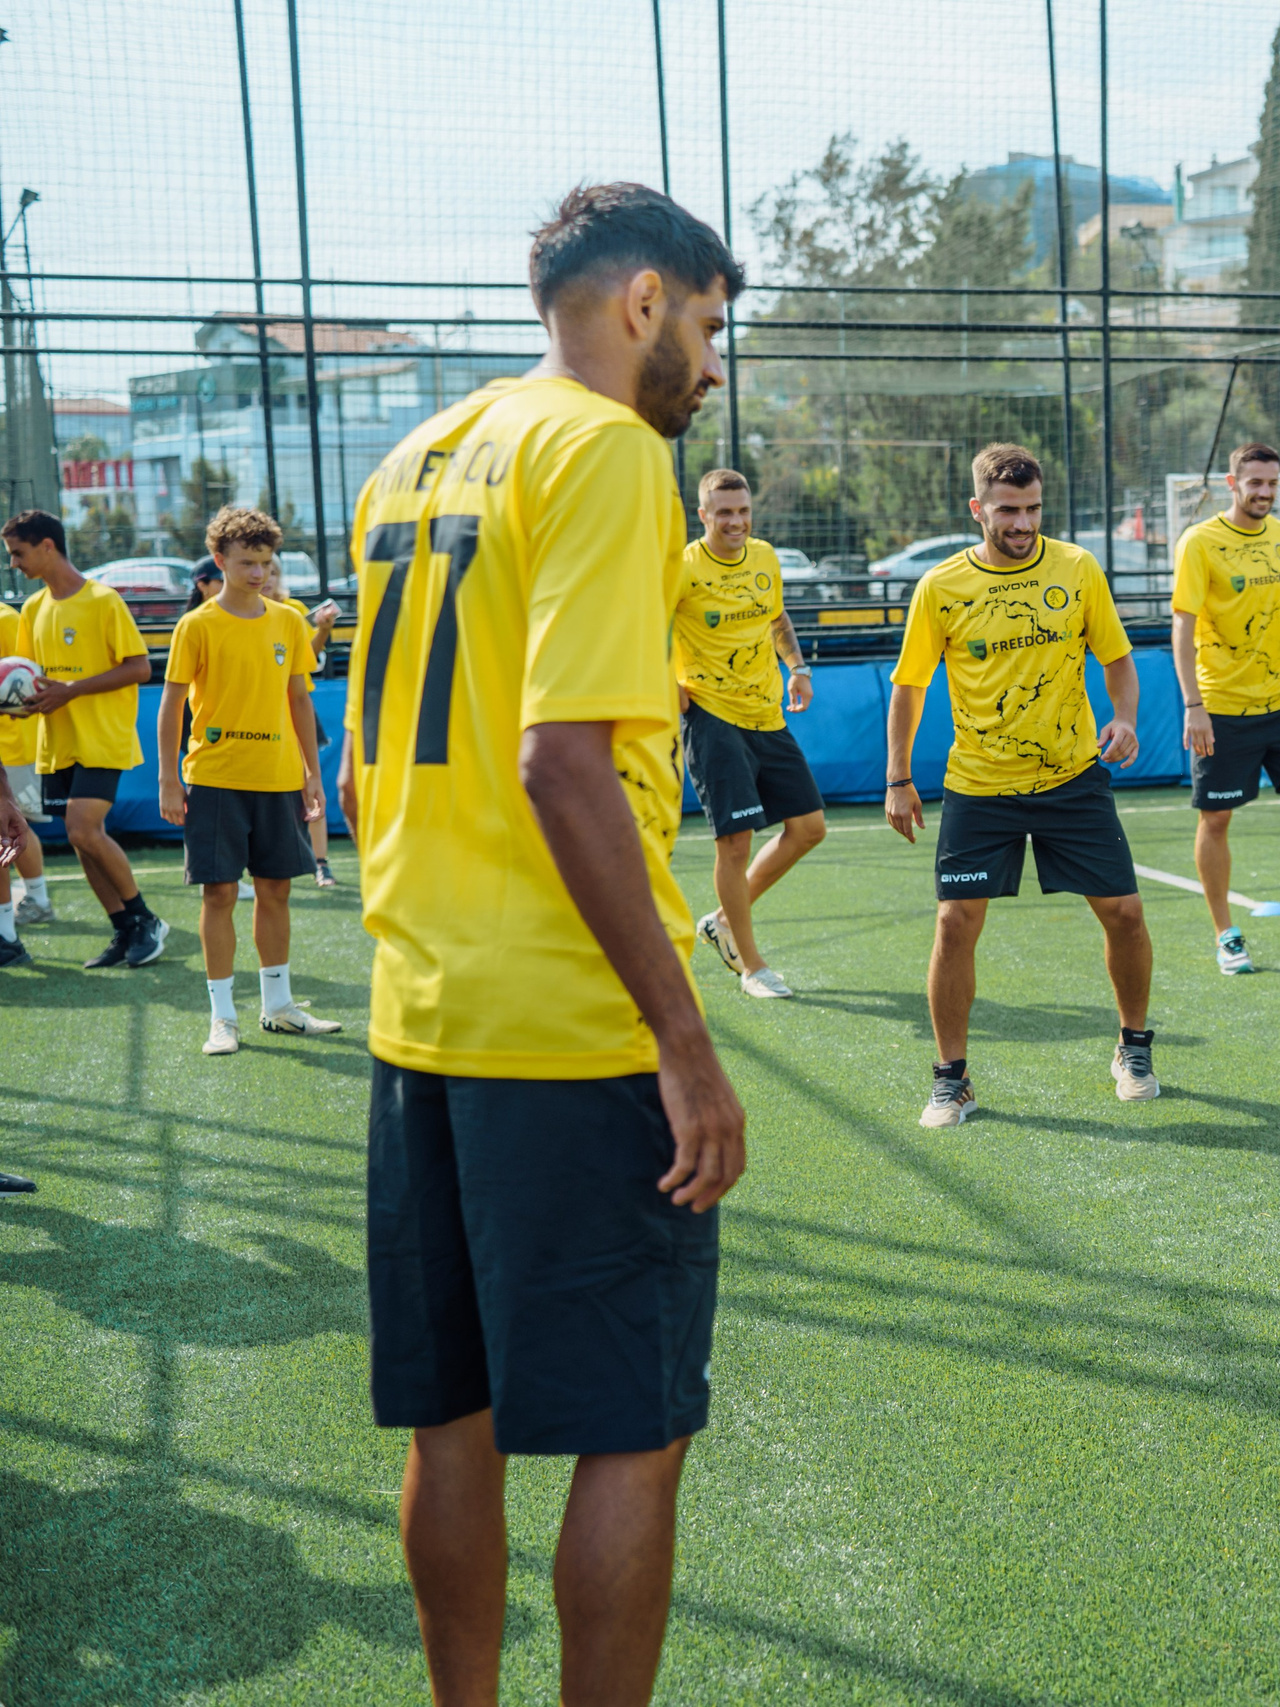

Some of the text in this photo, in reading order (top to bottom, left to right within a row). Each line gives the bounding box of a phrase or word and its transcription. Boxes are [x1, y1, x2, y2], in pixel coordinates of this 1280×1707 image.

[988, 580, 1039, 594] GIVOVA
[363, 514, 480, 764] 77
[941, 871, 988, 882] GIVOVA
